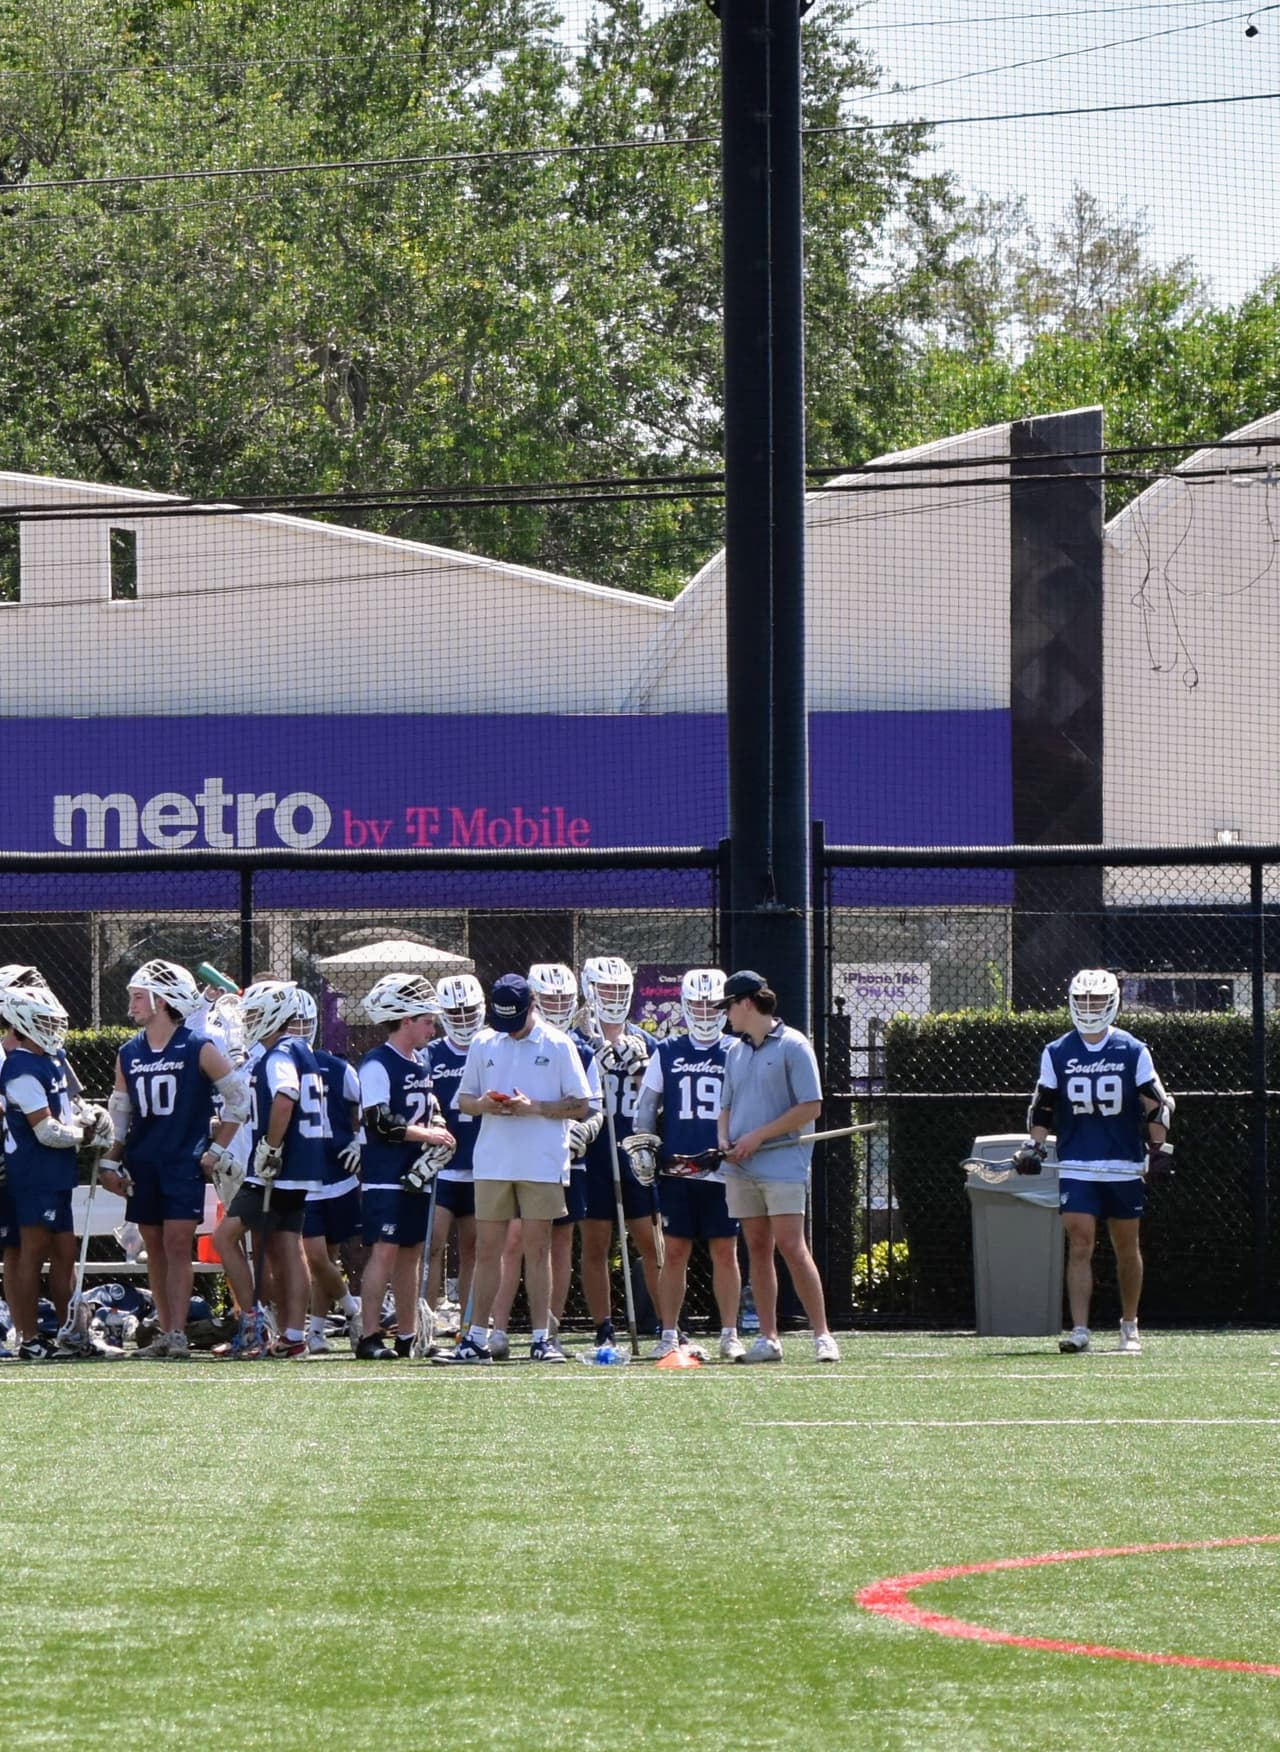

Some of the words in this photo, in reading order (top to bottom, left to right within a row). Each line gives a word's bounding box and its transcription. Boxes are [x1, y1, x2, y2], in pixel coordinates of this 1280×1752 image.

[53, 777, 332, 848] metro
[343, 809, 393, 848] by
[449, 807, 591, 848] Mobile
[843, 973, 893, 984] iPhone
[130, 1057, 185, 1075] Southern
[1064, 1058, 1127, 1074] Southern
[136, 1074, 177, 1118] 10
[403, 1073, 434, 1091] South
[1067, 1075, 1123, 1117] 99
[678, 1075, 722, 1120] 19
